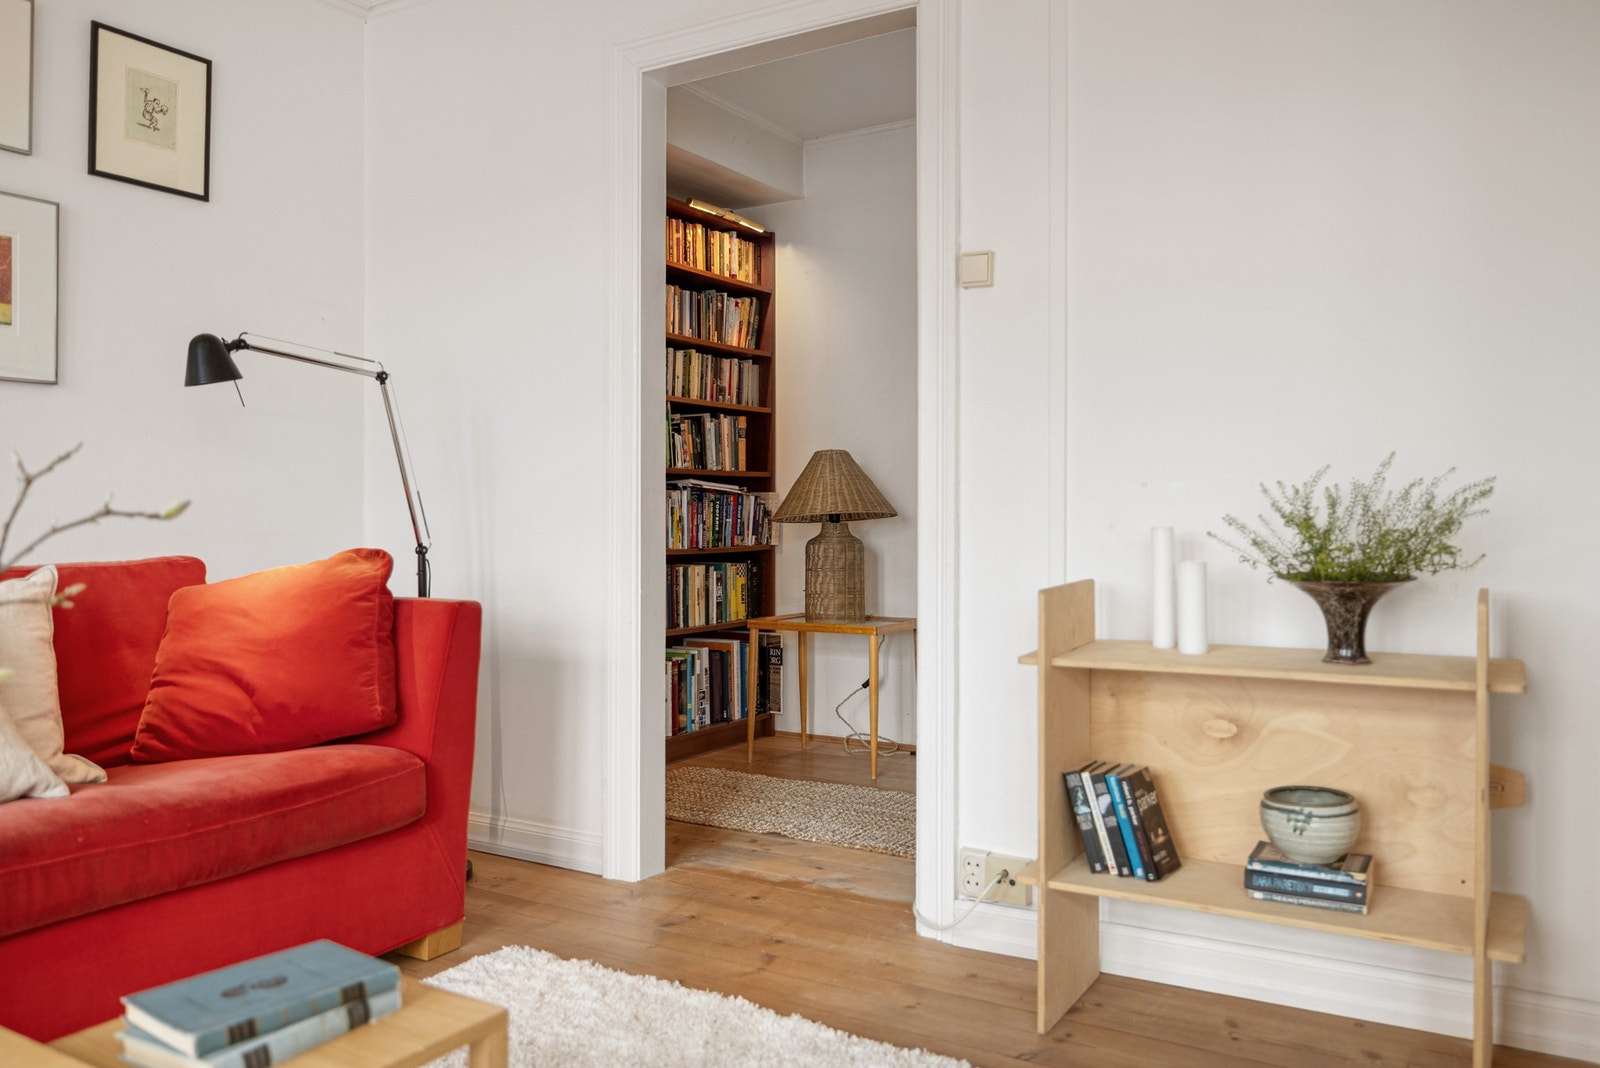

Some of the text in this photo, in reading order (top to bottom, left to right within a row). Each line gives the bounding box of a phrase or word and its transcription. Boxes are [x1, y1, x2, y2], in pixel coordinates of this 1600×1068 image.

[1121, 780, 1131, 799] robert
[1128, 805, 1139, 826] parker
[1252, 874, 1272, 890] SARA
[1273, 877, 1313, 893] PARETSKY
